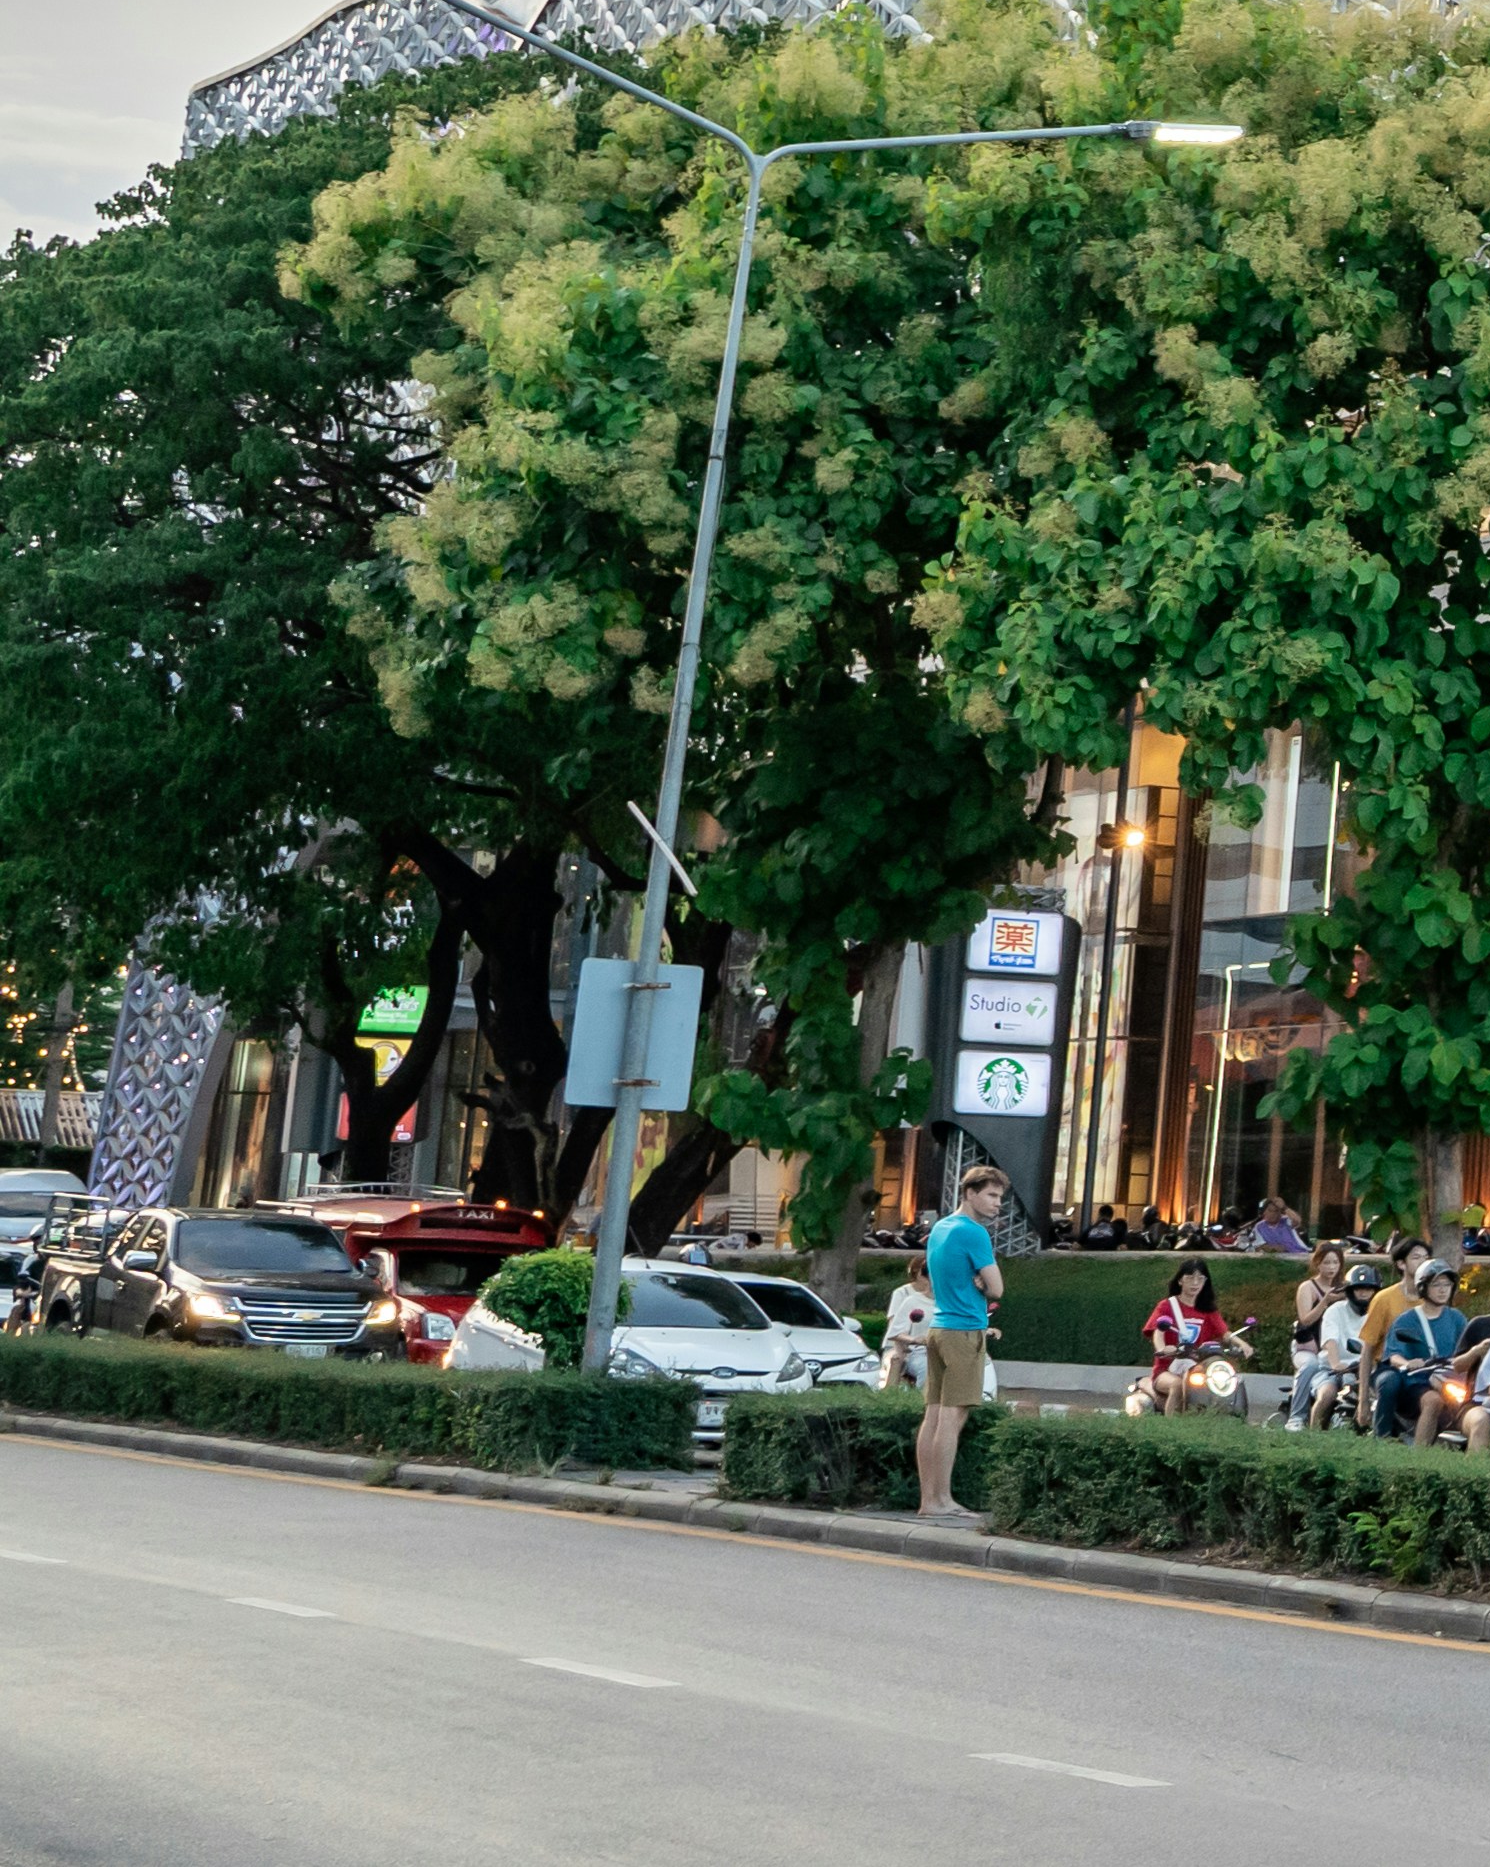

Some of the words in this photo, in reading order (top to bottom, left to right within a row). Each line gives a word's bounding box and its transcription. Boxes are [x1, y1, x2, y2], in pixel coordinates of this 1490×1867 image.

[996, 921, 1034, 954] 薬
[969, 993, 1022, 1013] Studio
[457, 1208, 495, 1220] TAXI
